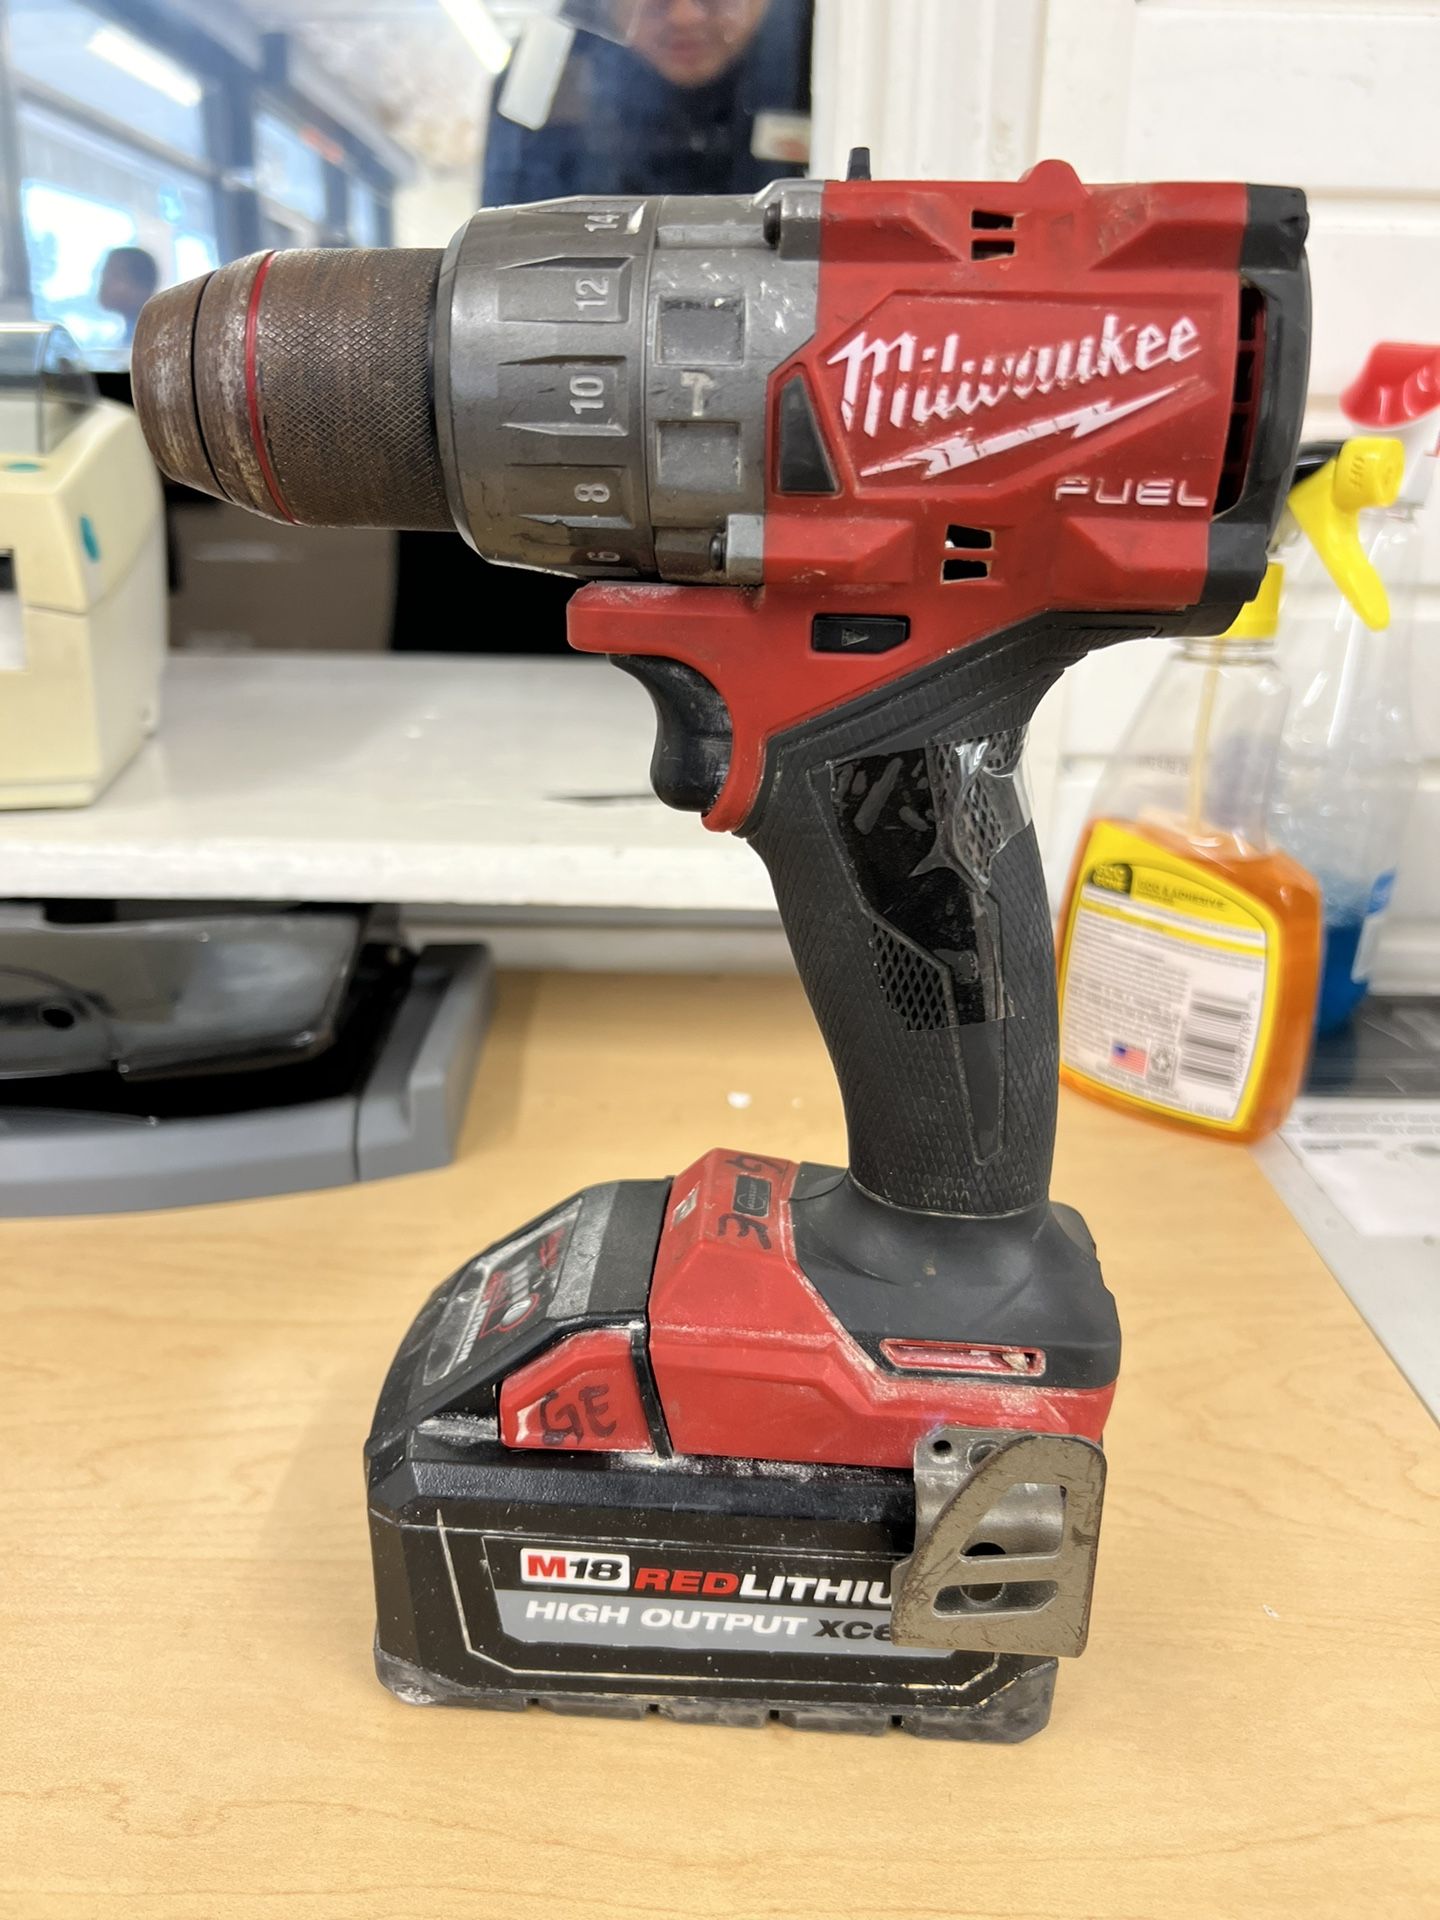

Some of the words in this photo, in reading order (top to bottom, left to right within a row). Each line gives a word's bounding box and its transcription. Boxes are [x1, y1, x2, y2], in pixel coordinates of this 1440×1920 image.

[585, 210, 620, 232] 14
[574, 278, 609, 312] 12
[827, 313, 1202, 438] Milwaukee
[569, 375, 604, 414] 10
[574, 483, 610, 503] 8
[1054, 475, 1209, 508] FUEL
[540, 1384, 617, 1446] GE
[527, 1555, 623, 1581] M18
[634, 1567, 892, 1606] REDLITHIU
[525, 1600, 630, 1625] HIGH
[640, 1608, 808, 1635] OUTPUT
